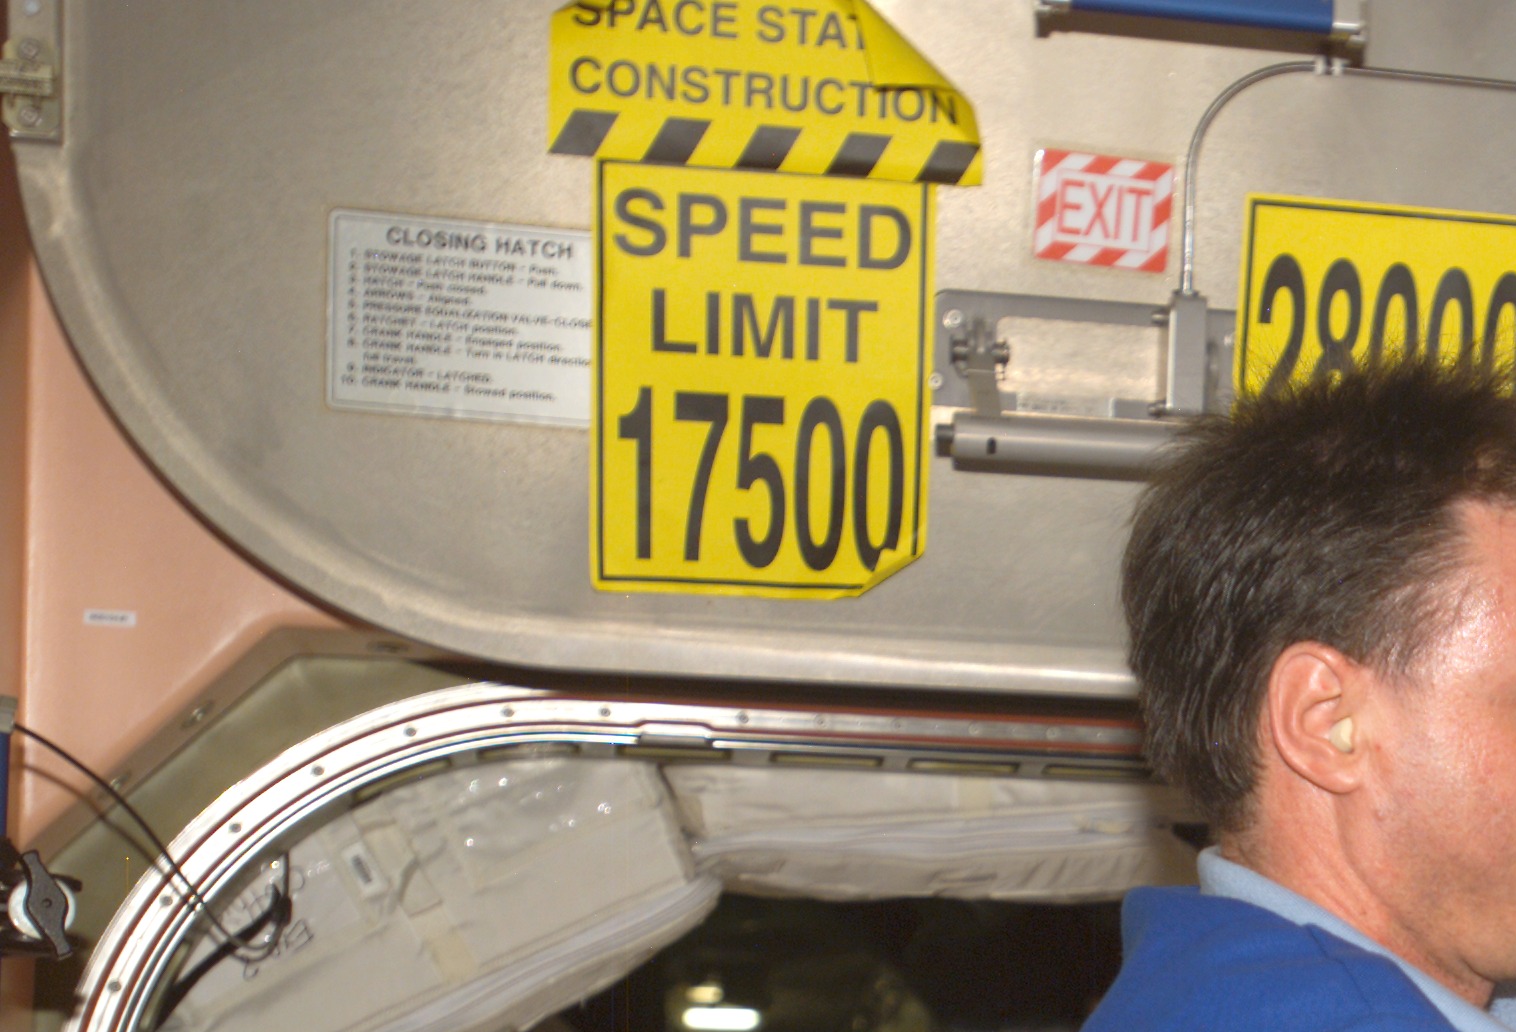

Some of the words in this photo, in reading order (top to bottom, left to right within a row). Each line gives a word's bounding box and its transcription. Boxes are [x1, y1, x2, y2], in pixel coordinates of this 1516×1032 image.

[571, 0, 738, 38] SPACE
[756, 5, 865, 49] STAT
[569, 56, 957, 125] CONSTRUCTION
[1057, 178, 1155, 244] EXIT
[613, 187, 912, 271] SPEED
[385, 226, 488, 252] CLOSING
[495, 238, 575, 260] HATCH
[364, 249, 422, 262] STOWAGE
[426, 255, 465, 268] LATCH
[363, 261, 422, 276] STOWAGE
[426, 267, 465, 281] LATCH
[468, 272, 515, 286] HANDLE
[363, 276, 404, 288] HATCH
[364, 288, 414, 301] ARROWS
[362, 300, 422, 314] PRESSURE
[425, 305, 508, 322] EQUALIZATION
[362, 313, 418, 327] RATCHET
[430, 320, 468, 333] LATCH
[362, 325, 402, 338] CRANK
[406, 330, 452, 343] HANDLE
[650, 287, 879, 364] LIMIT
[362, 338, 402, 350] CRANK
[406, 342, 452, 356] HANDLE
[505, 350, 545, 364] LATCH
[361, 363, 424, 378] INDICATOR
[361, 376, 402, 388] CRANK
[405, 381, 451, 394] HANDLE
[617, 385, 905, 572] 17500
